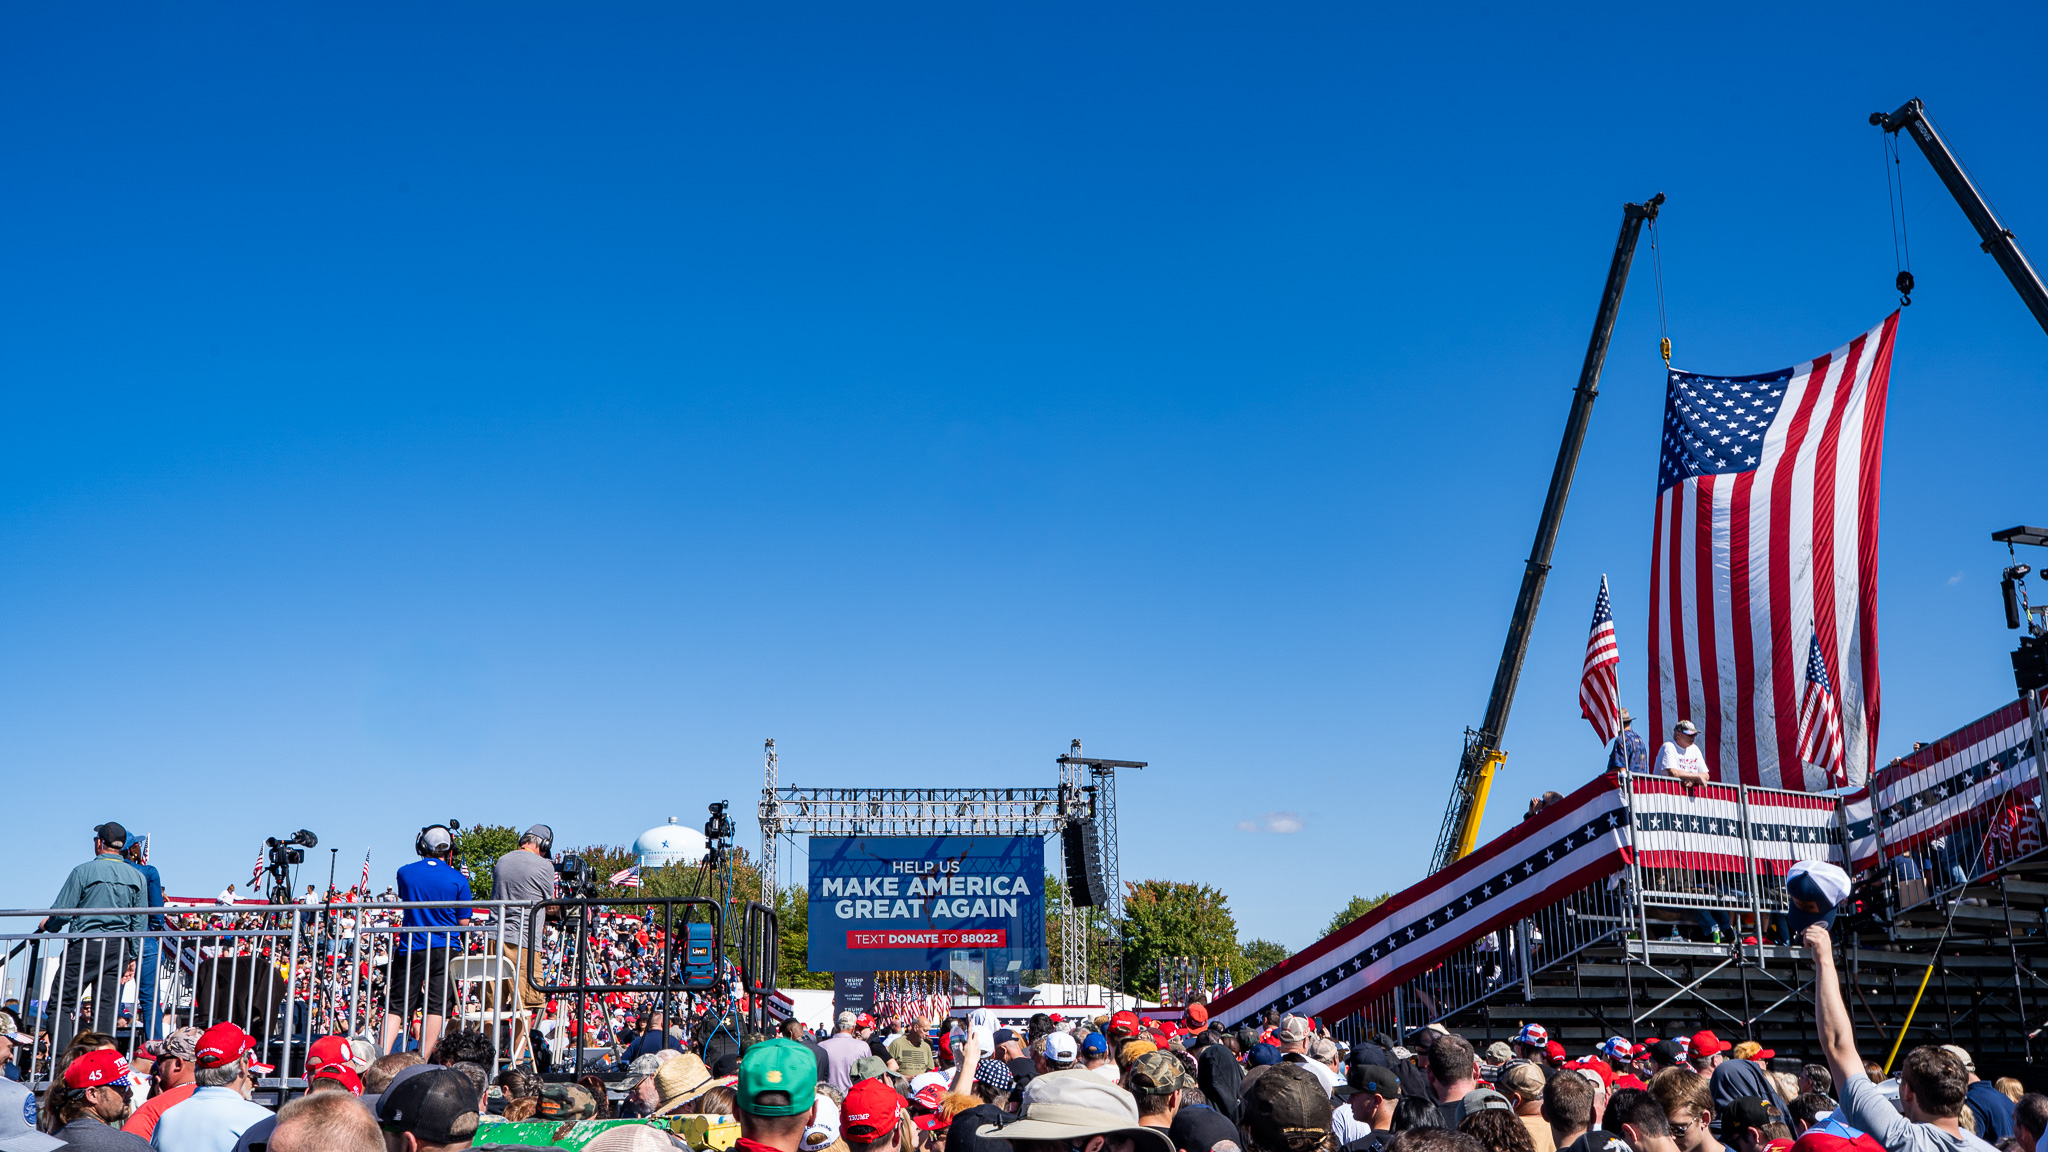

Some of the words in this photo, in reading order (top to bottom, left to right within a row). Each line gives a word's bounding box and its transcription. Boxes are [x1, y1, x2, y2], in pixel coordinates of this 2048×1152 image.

[892, 861, 934, 874] HELP
[939, 860, 960, 873] US
[822, 877, 899, 897] MAKE
[906, 876, 1031, 896] AMERICA
[834, 899, 925, 919] GREAT
[931, 898, 1018, 918] AGAIN
[855, 934, 886, 944] TEXT
[888, 933, 939, 944] DONATE
[942, 933, 958, 944] TO
[961, 933, 998, 943] 88022
[692, 947, 707, 955] LiveU
[88, 1069, 103, 1081] 45
[848, 1113, 870, 1121] TRUMP
